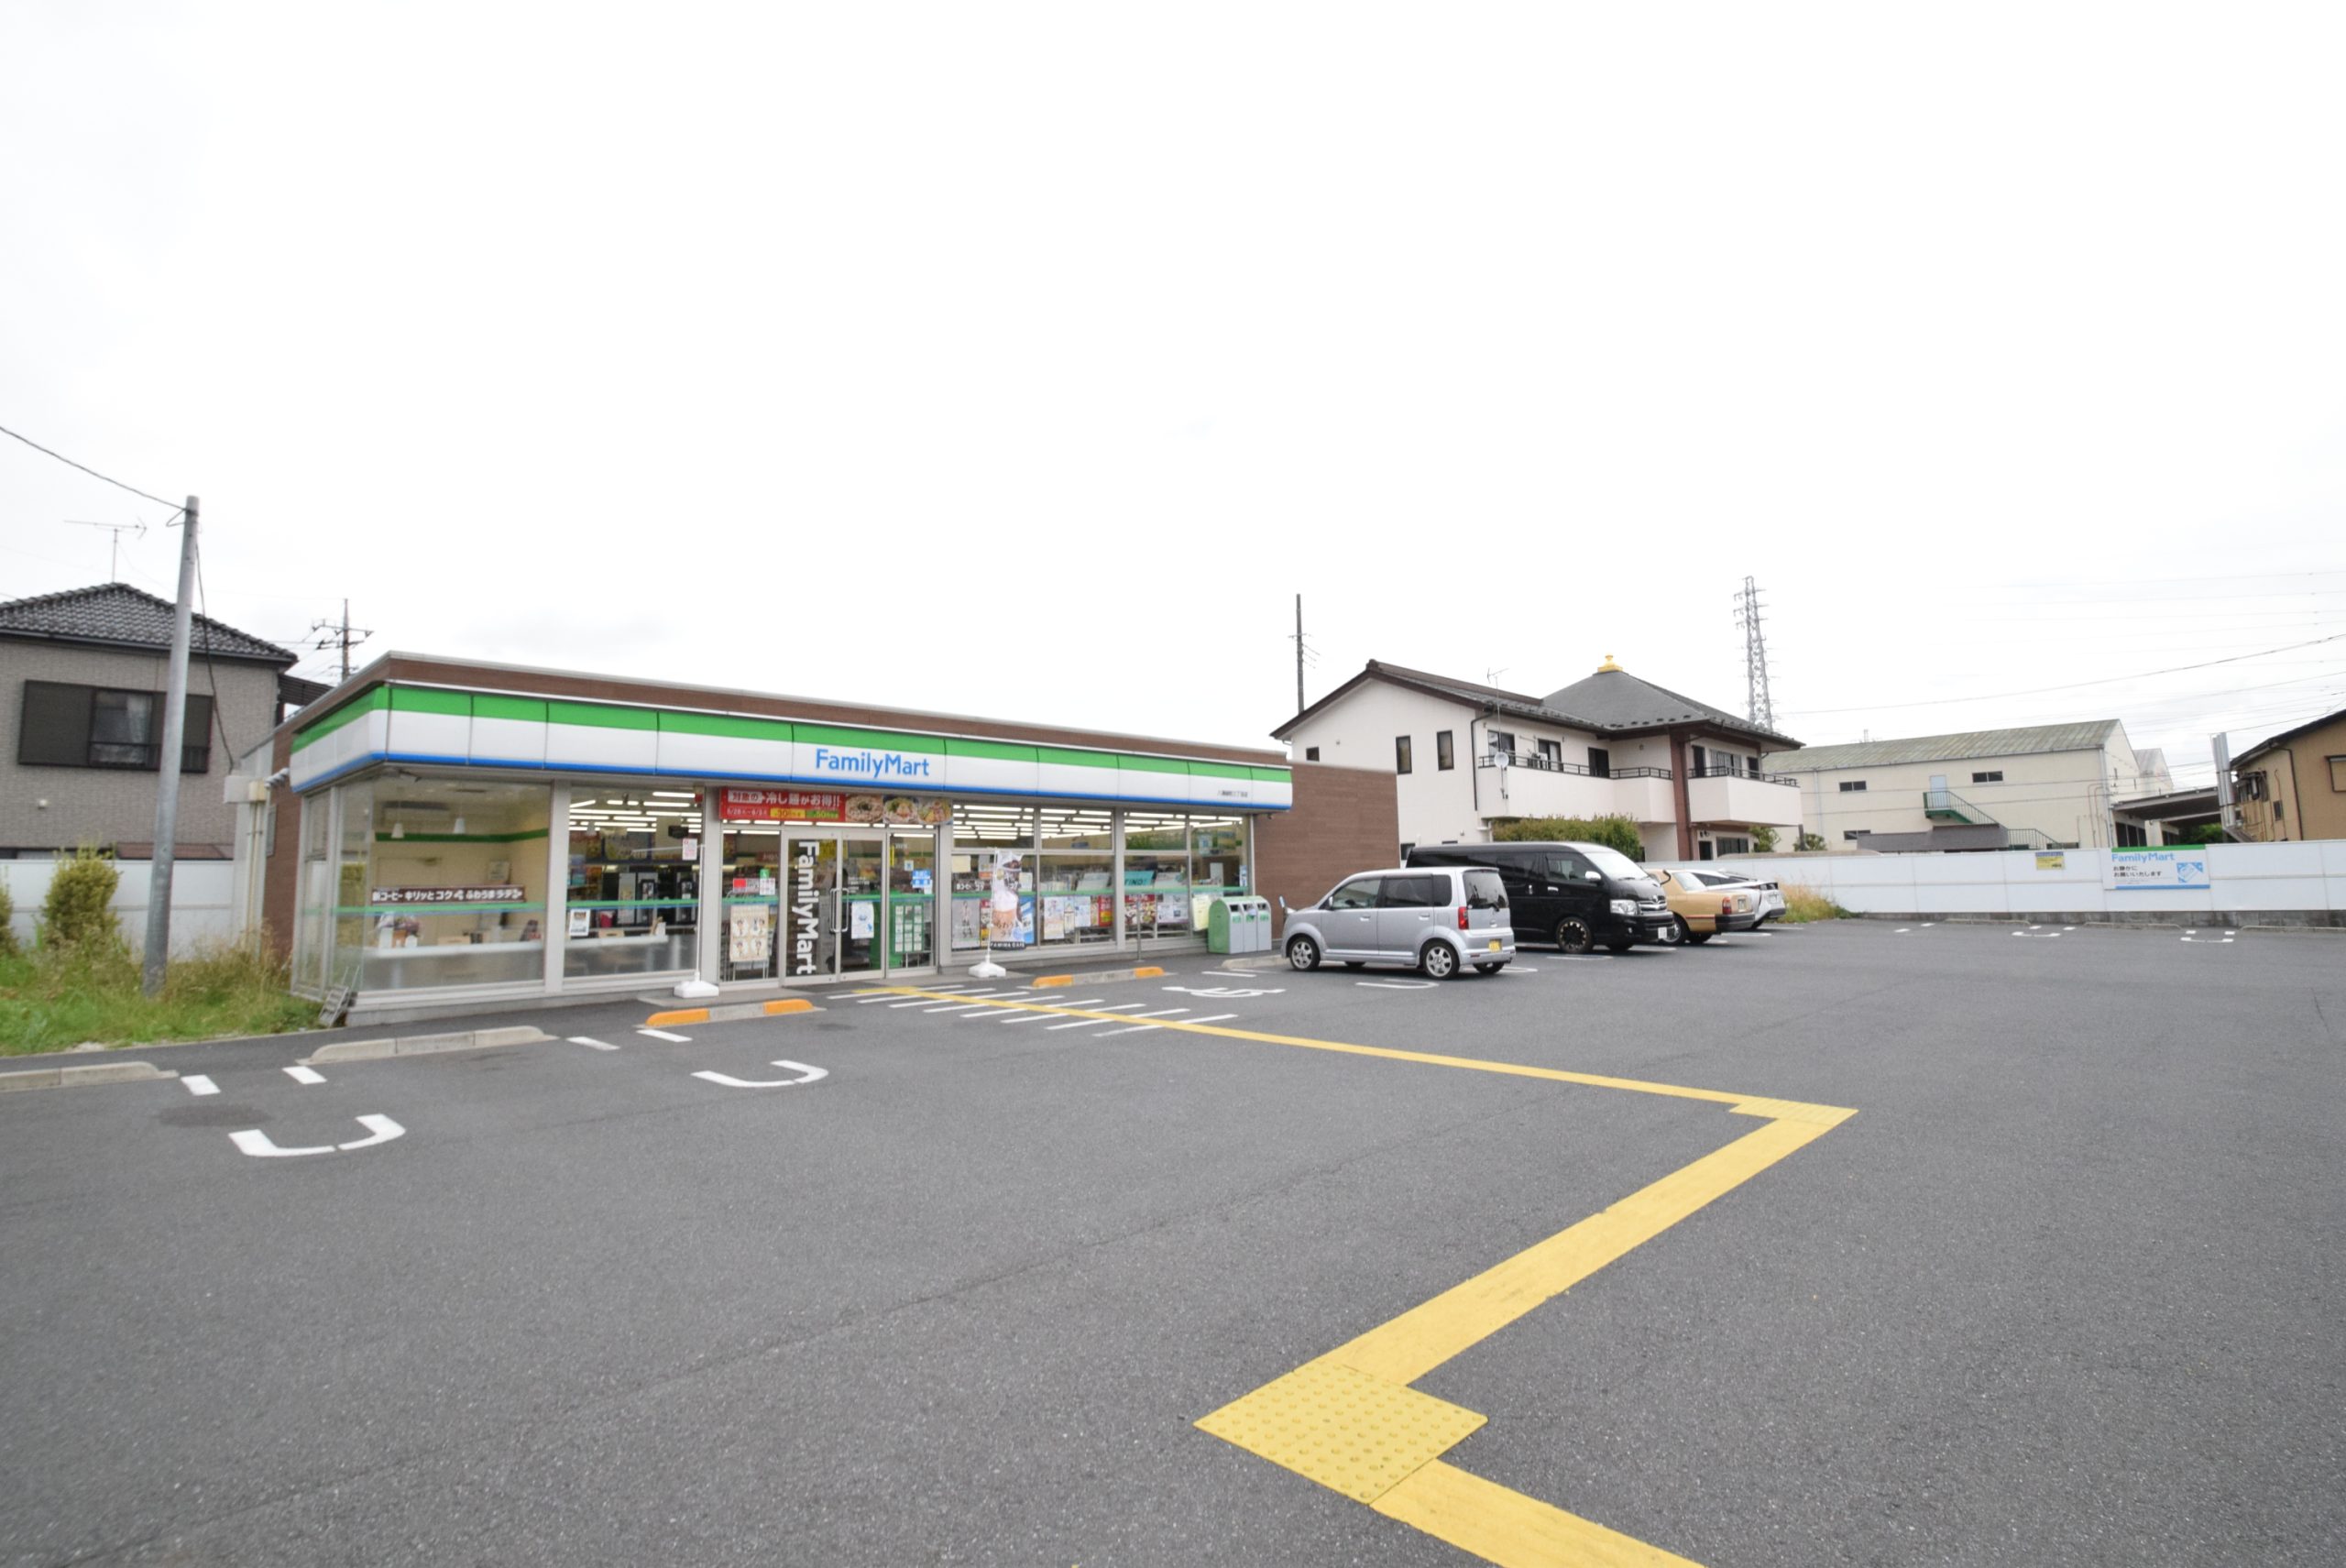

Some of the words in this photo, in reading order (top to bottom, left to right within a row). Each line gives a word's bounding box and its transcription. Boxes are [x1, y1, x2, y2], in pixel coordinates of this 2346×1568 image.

[816, 748, 929, 778] FamilyMart
[2111, 852, 2175, 863] FamilyMart
[792, 841, 819, 974] FamilyMart
